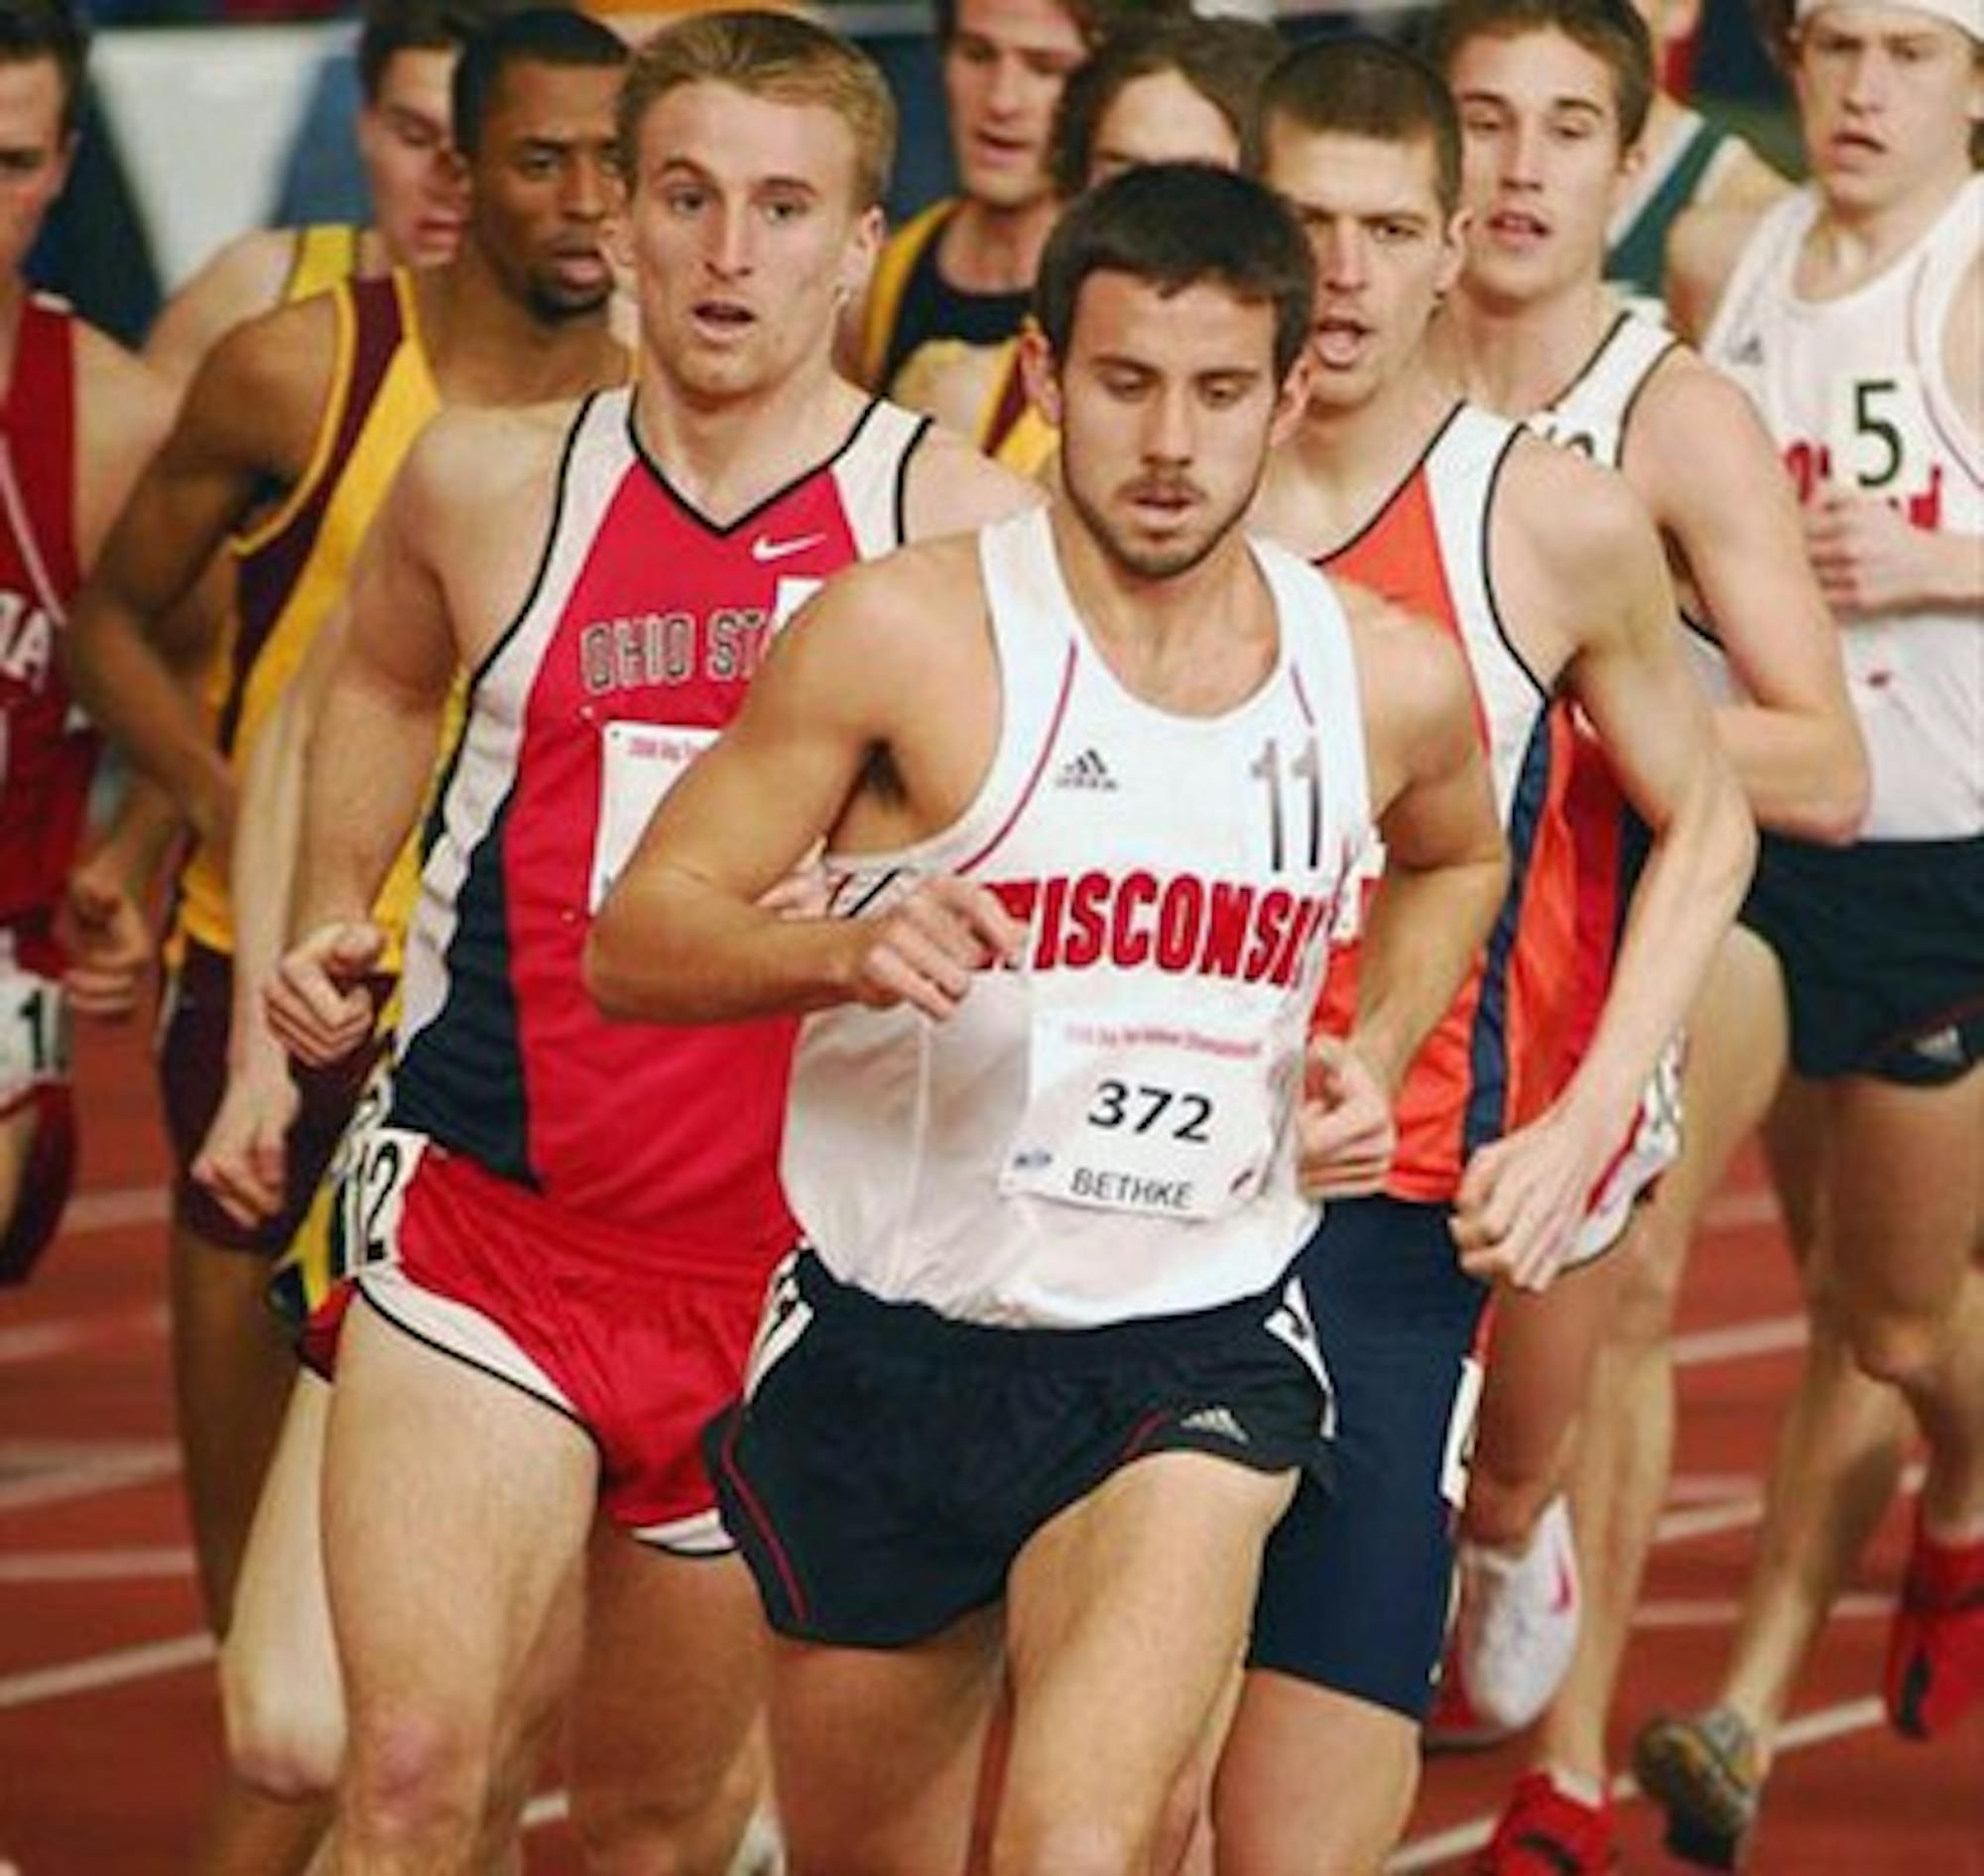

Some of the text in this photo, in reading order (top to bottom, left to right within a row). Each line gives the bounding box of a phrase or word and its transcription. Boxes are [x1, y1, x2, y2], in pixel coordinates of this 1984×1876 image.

[1855, 380, 1903, 486] 5
[581, 612, 696, 694] OHIO
[1252, 738, 1321, 872] 11
[970, 870, 1329, 989] ISCONSI
[1087, 1079, 1215, 1144] 372
[1069, 1167, 1193, 1208] BETHKE
